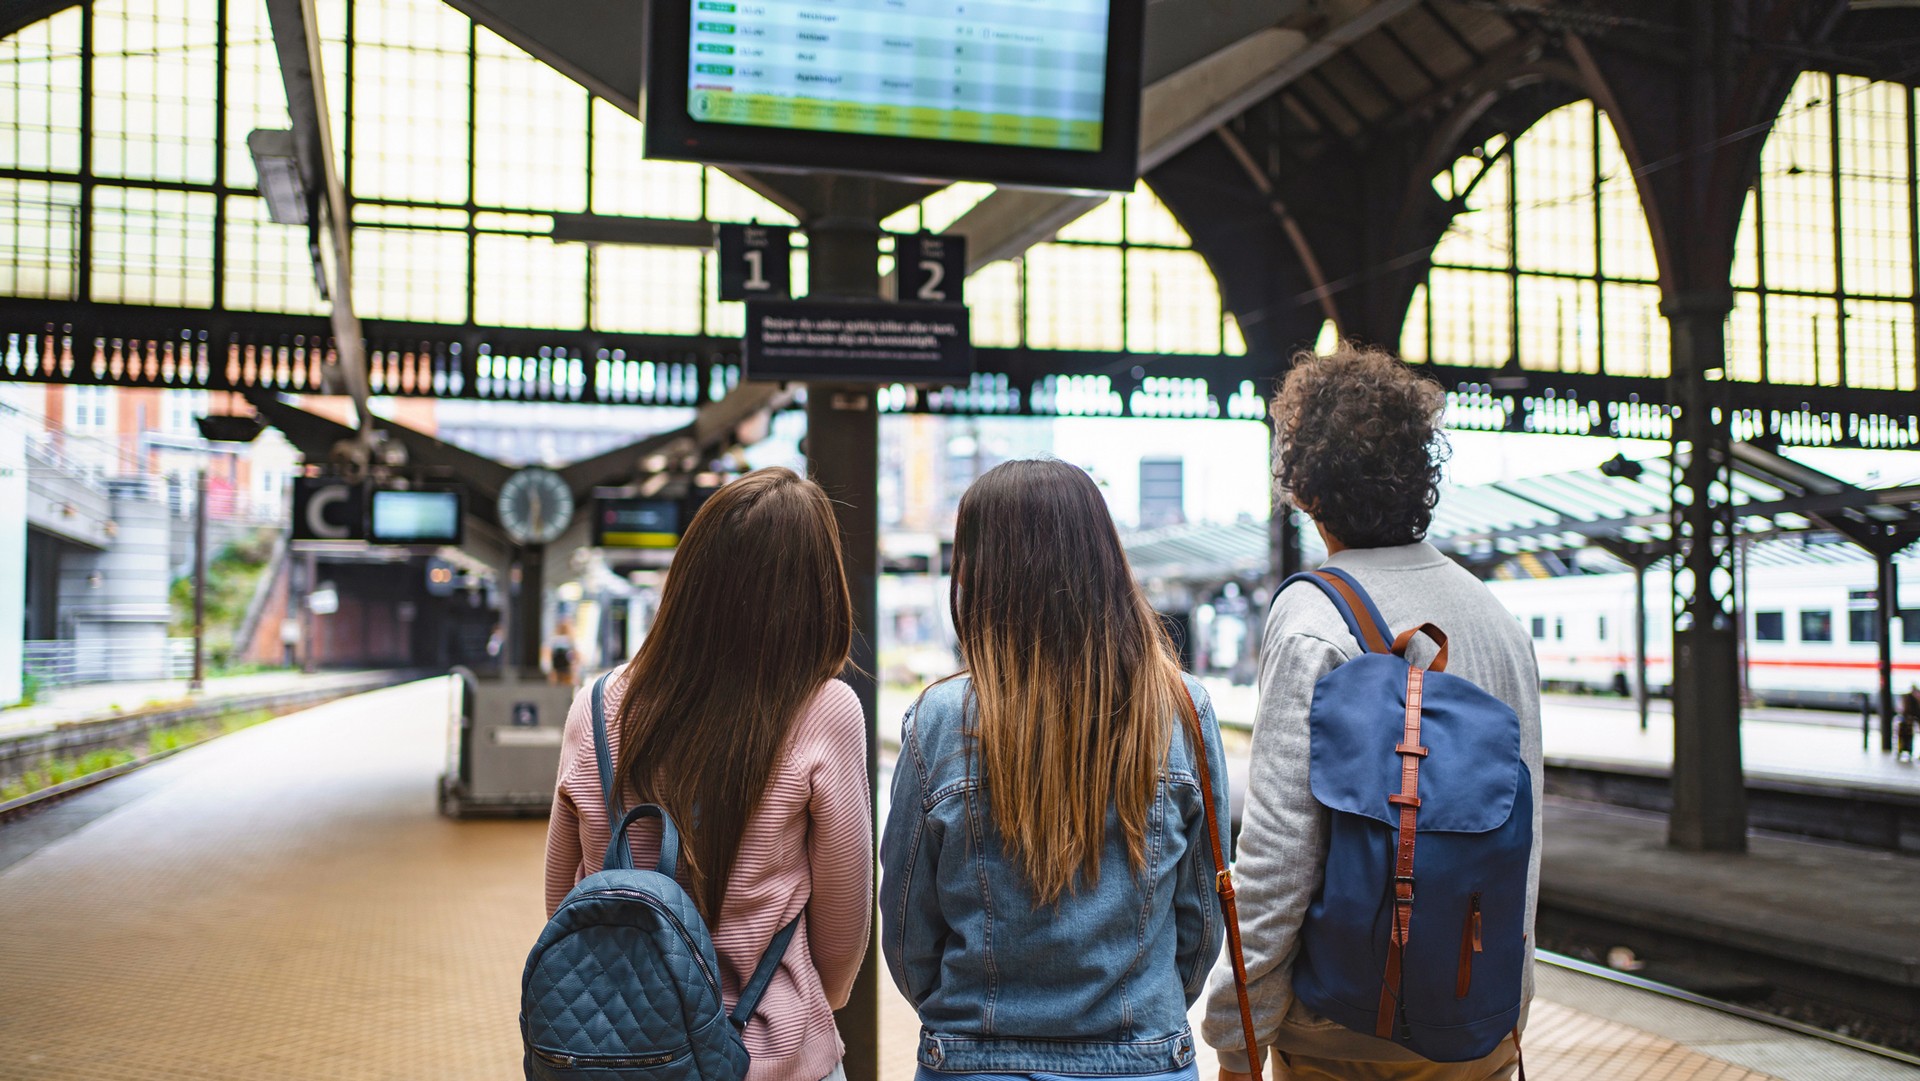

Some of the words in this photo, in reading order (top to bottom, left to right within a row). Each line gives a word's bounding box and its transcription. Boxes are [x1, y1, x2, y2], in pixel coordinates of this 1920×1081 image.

[743, 250, 770, 290] 1
[917, 261, 946, 300] 2
[306, 485, 350, 538] C
